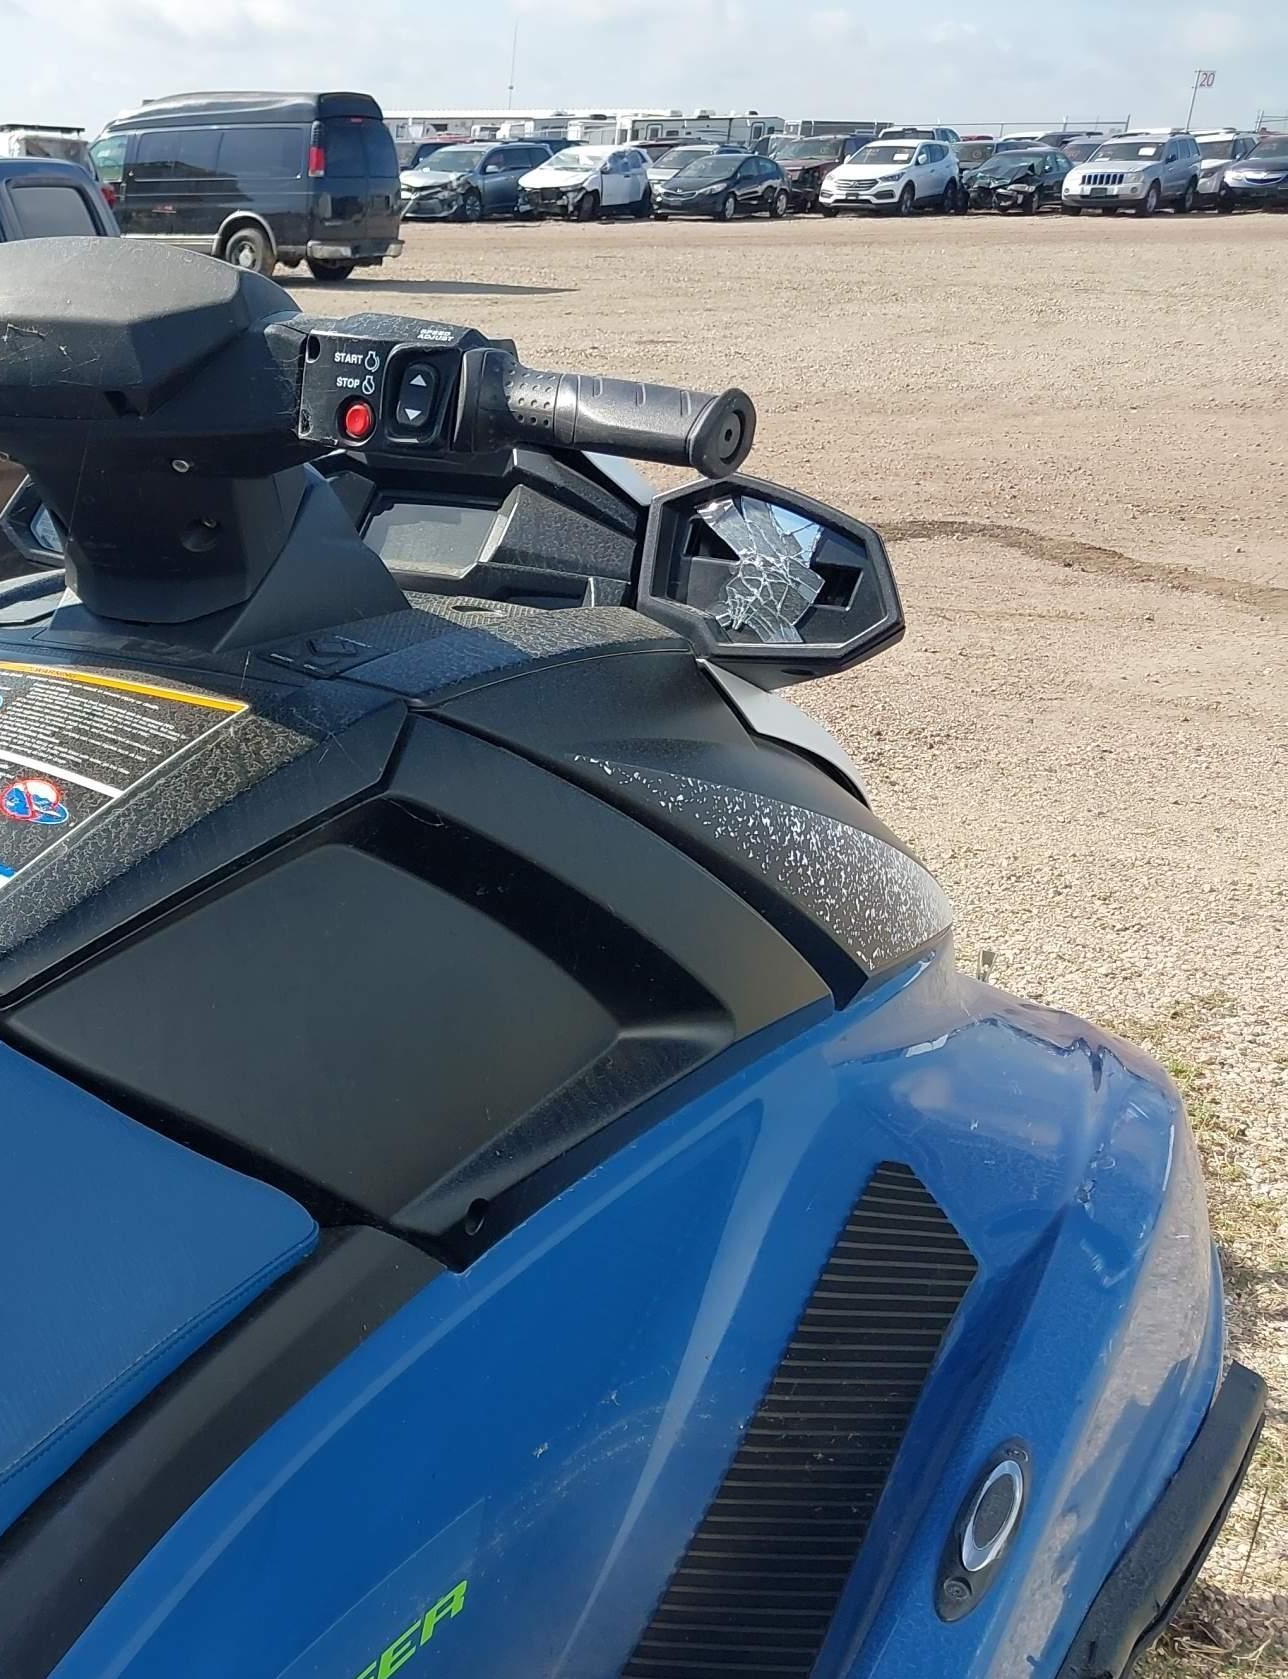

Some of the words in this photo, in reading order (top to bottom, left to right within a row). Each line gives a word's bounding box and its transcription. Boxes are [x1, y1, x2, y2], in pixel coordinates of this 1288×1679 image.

[1199, 72, 1215, 87] 20
[417, 334, 454, 342] ADJUST
[334, 352, 363, 365] START
[336, 376, 360, 389] STOP
